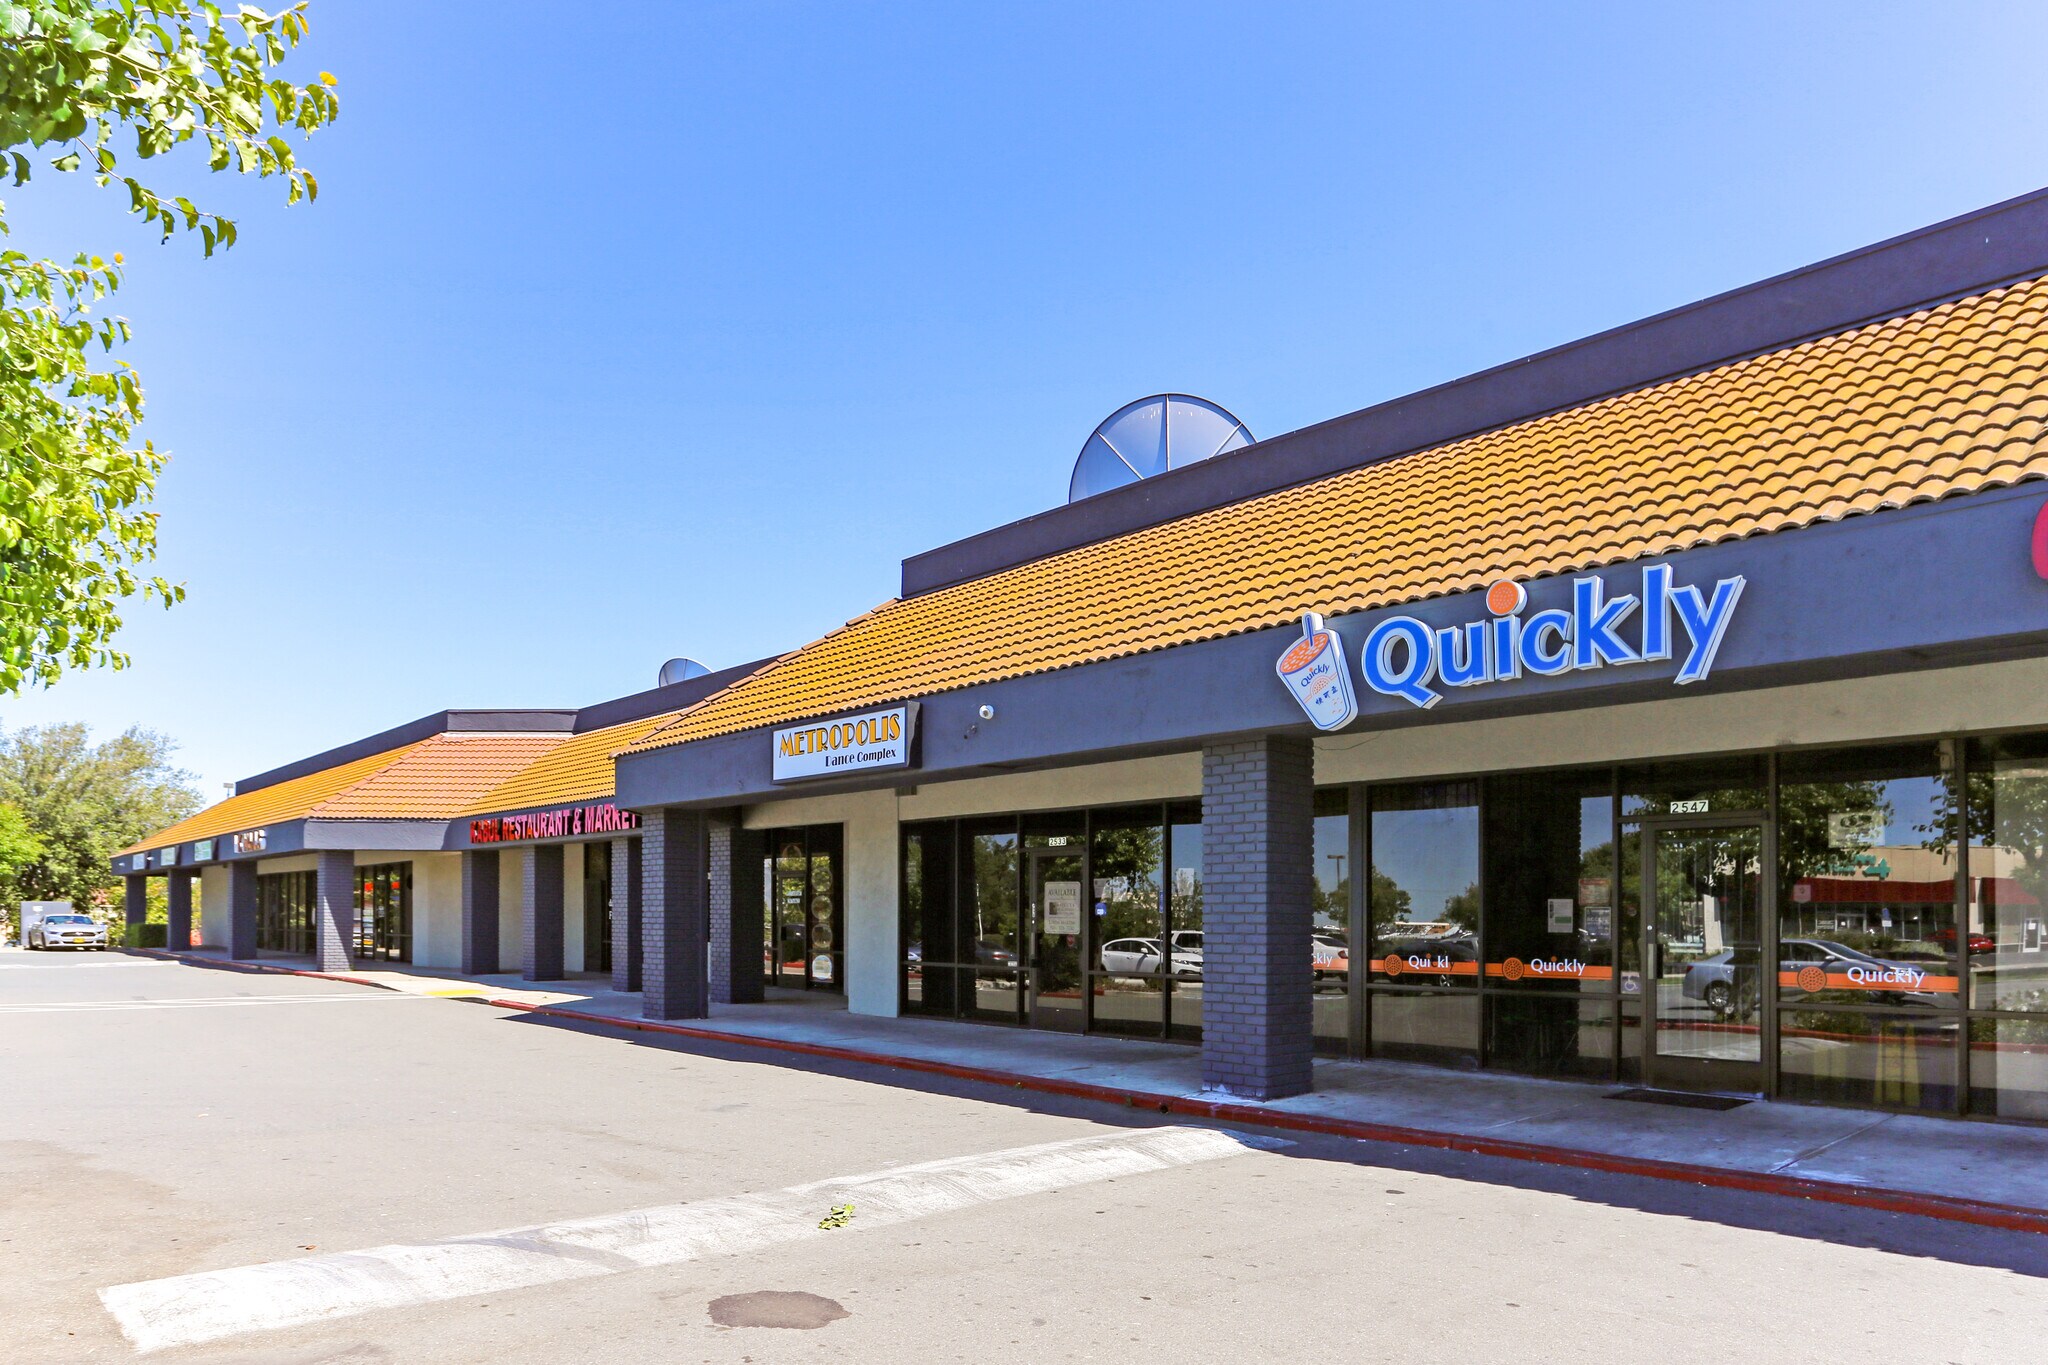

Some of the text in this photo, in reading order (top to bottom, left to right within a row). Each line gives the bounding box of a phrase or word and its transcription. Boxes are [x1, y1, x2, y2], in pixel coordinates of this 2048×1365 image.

[1362, 563, 1747, 709] Quickly
[1301, 664, 1330, 687] Quickly
[779, 713, 901, 758] METROPOLIS
[825, 748, 897, 767] Dance Complex
[1671, 801, 1707, 813] 2547
[470, 818, 499, 844] KABUL
[502, 809, 570, 841] RESTAURANT
[573, 808, 582, 835] &
[1050, 837, 1066, 846] 2533
[1530, 957, 1586, 976] Quickly
[1847, 966, 1925, 988] Quickly
